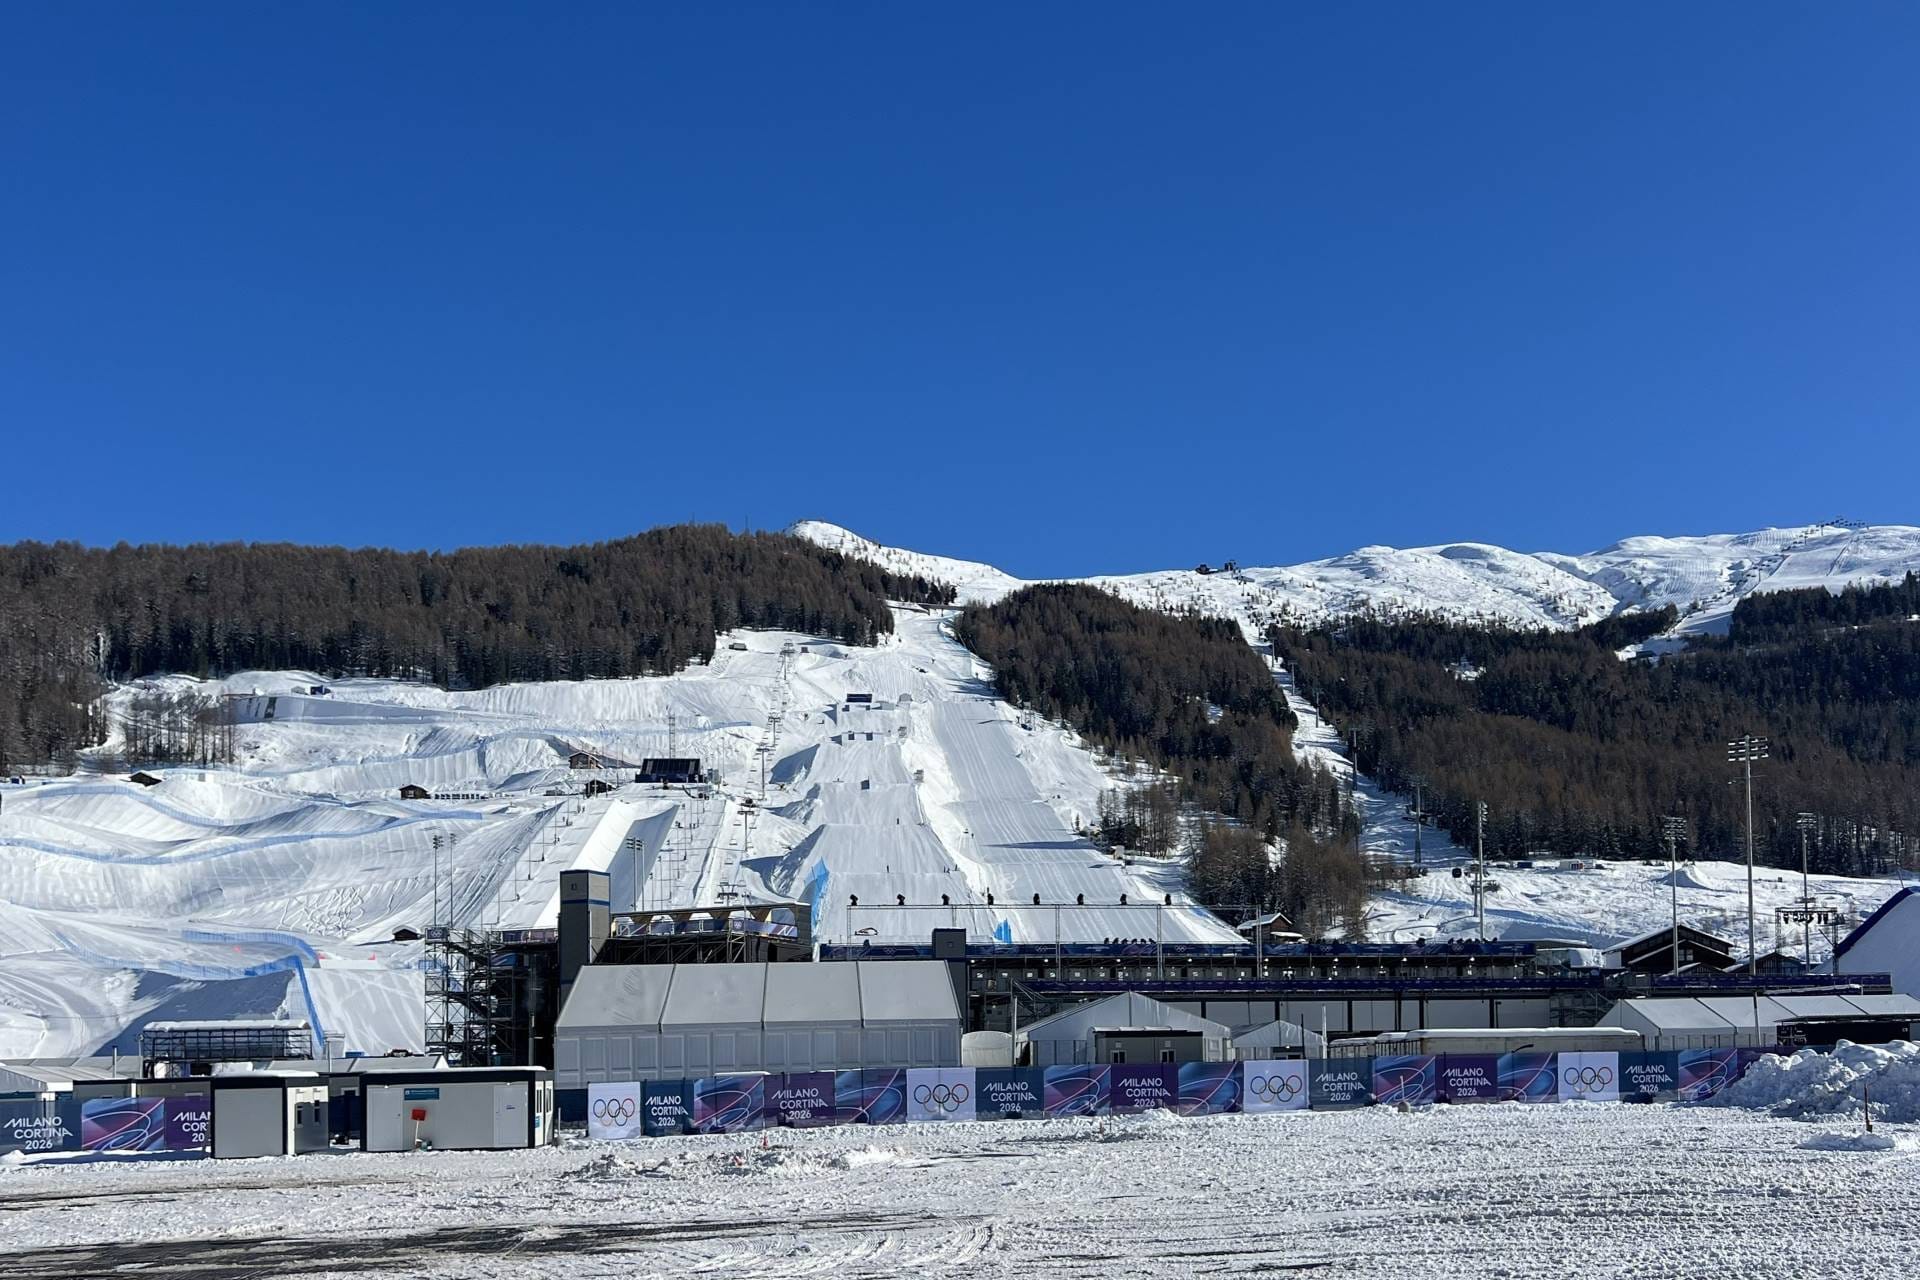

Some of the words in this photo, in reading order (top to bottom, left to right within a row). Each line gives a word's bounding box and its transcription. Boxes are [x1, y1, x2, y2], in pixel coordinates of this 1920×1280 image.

[1442, 1067, 1484, 1077] MILANO
[1625, 1064, 1665, 1074] MILANO
[1118, 1077, 1163, 1087] MILANO
[1315, 1072, 1358, 1082] MILANO
[1449, 1077, 1492, 1087] CORTINA
[1632, 1074, 1673, 1084] CORTINA
[983, 1081, 1029, 1092] MILANO
[1322, 1082, 1367, 1092] CORTINA
[1640, 1084, 1659, 1093] 2026
[771, 1088, 819, 1100] MILANO
[991, 1092, 1038, 1102] CORTINA
[1126, 1087, 1172, 1097] CORTINA
[1330, 1092, 1351, 1102] 2026
[1457, 1087, 1477, 1097] 2026
[645, 1095, 682, 1106] MILANO
[780, 1099, 829, 1110] CORTINA
[1134, 1098, 1156, 1108] 2026
[651, 1106, 689, 1116] CORTINA
[1000, 1102, 1021, 1112] 2026
[789, 1110, 812, 1120] 2026
[3, 1116, 63, 1128] MILANO
[658, 1117, 676, 1126] 2026
[182, 1122, 208, 1132] COR
[14, 1127, 74, 1139] CORTINA
[25, 1139, 53, 1150] 2026
